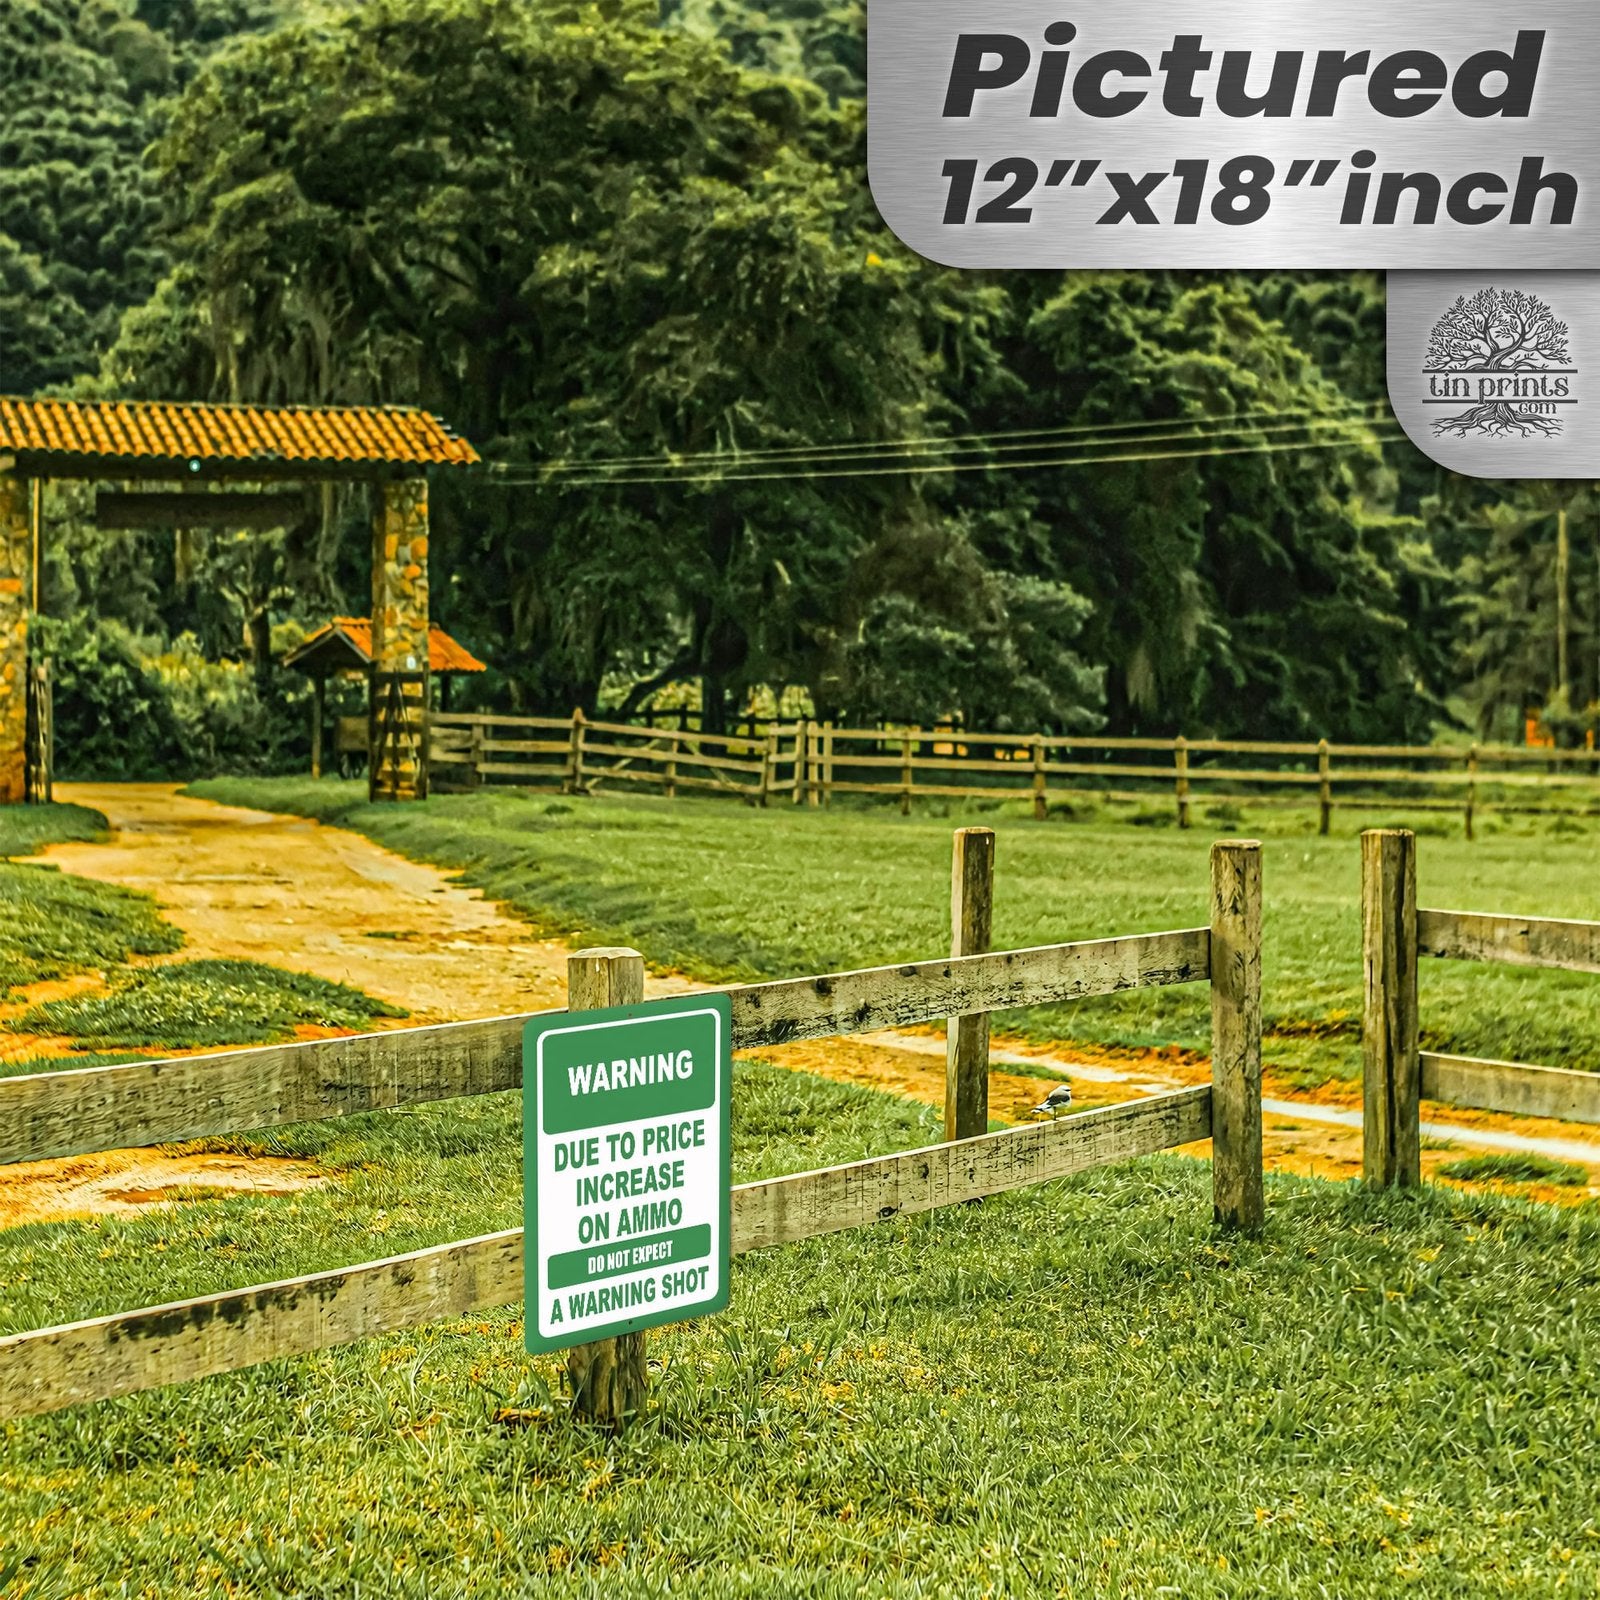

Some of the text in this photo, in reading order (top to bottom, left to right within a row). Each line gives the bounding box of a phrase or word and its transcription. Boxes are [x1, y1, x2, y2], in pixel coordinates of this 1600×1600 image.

[568, 1049, 693, 1096] WARNING
[554, 1119, 705, 1172] DUE TO PRICE
[576, 1160, 685, 1207] INCREASE
[578, 1198, 683, 1244] ON AMMO
[588, 1240, 673, 1274] DO NOT EXPECT
[550, 1266, 709, 1324] A WARNING SHOT
